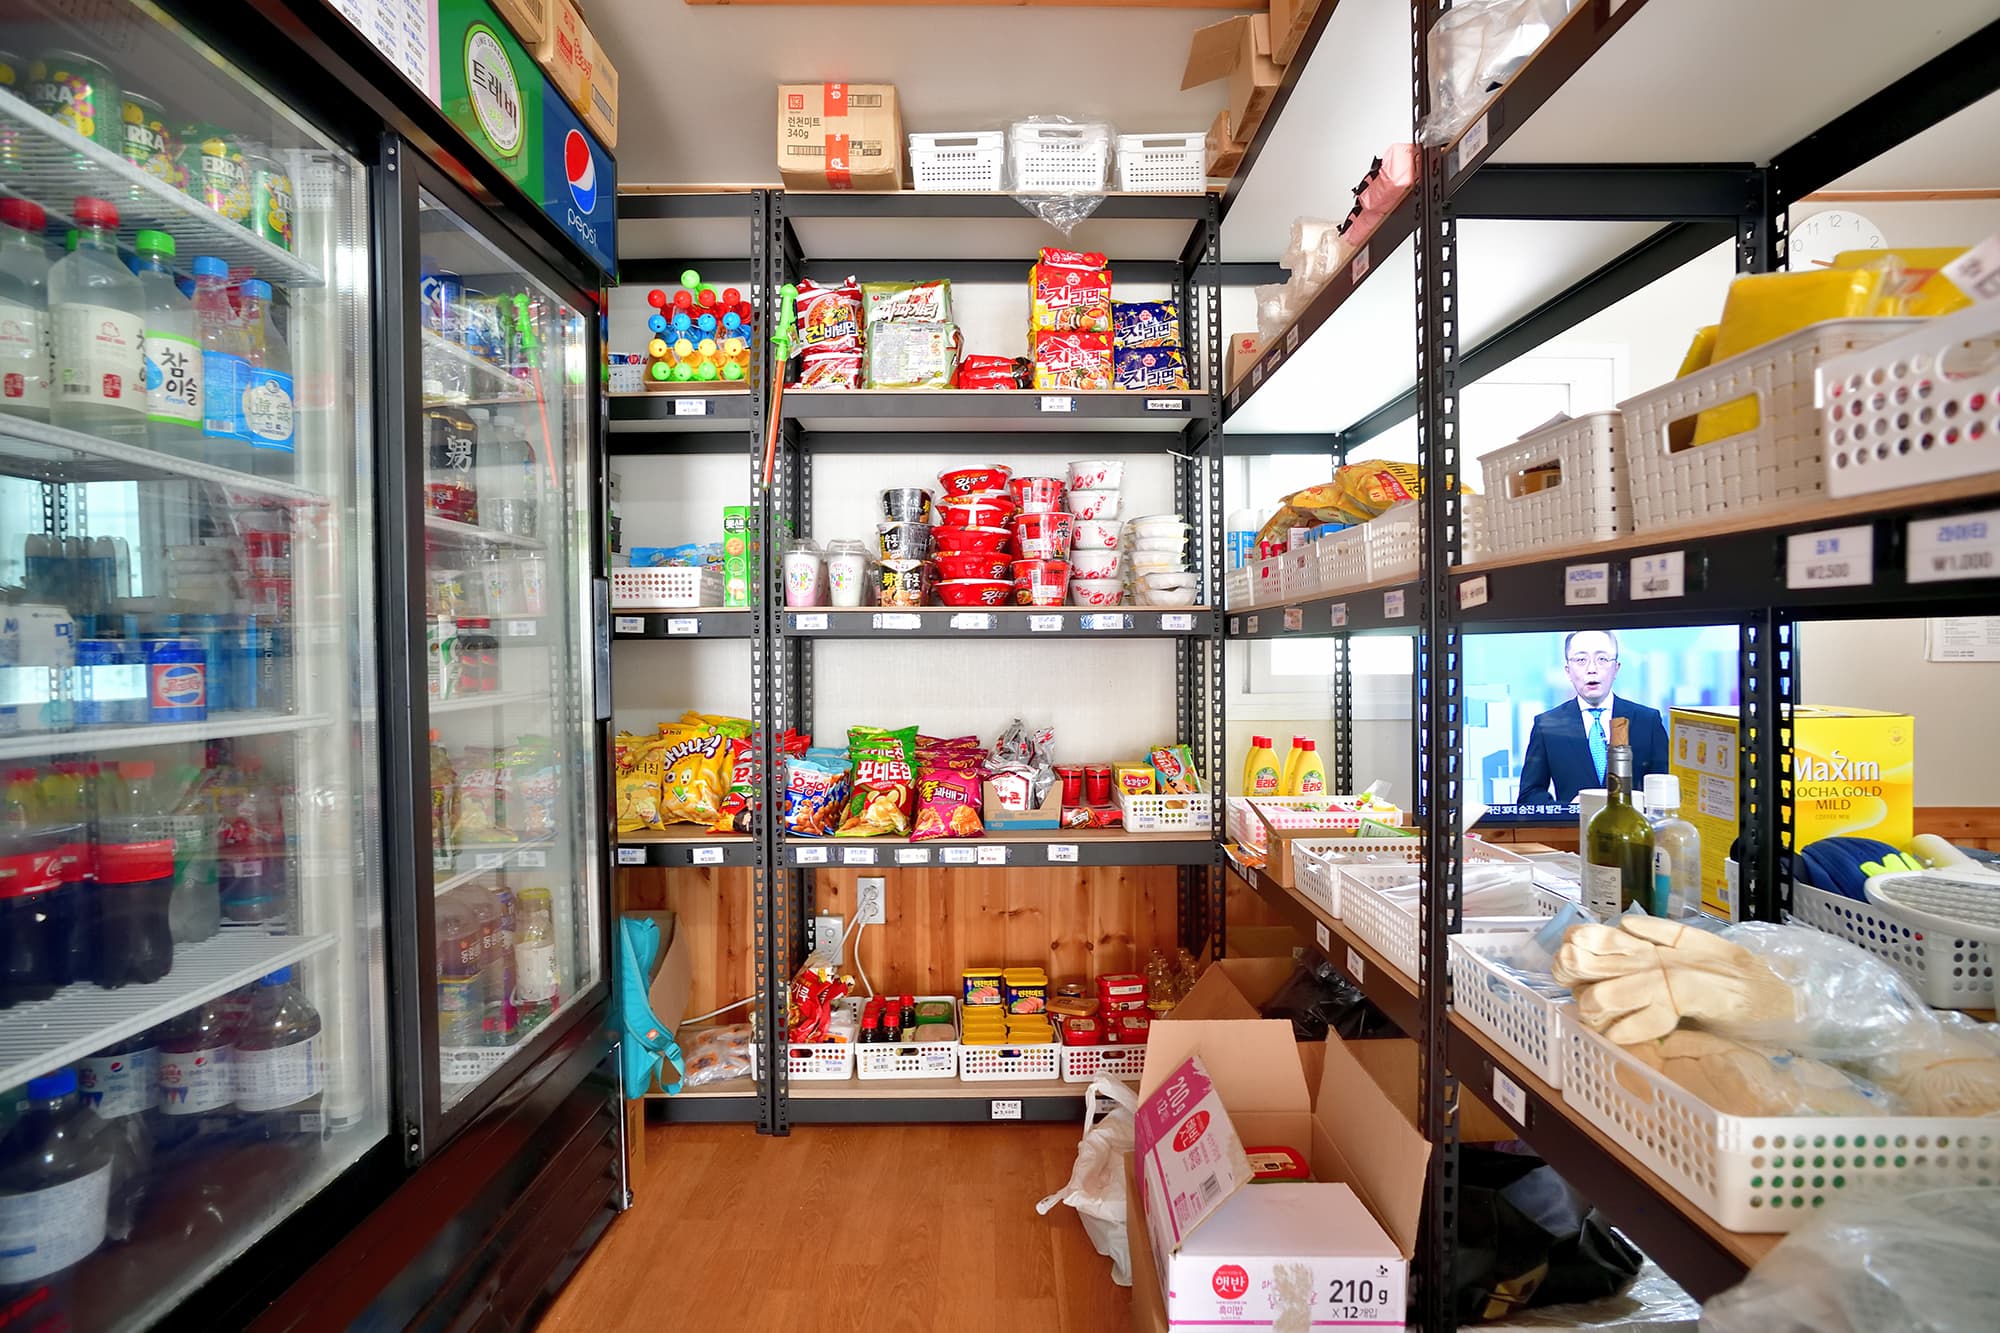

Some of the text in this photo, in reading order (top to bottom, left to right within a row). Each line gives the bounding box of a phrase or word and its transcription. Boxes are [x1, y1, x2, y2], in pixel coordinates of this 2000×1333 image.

[472, 59, 517, 128] 트레비
[787, 116, 822, 128] 런천미트
[787, 128, 809, 139] 340g
[567, 207, 597, 247] pepsi
[1807, 222, 1819, 236] 11
[1830, 214, 1842, 228] 12
[1855, 219, 1861, 232] 1
[1791, 238, 1804, 253] 10
[1869, 235, 1880, 248] 2
[1045, 285, 1100, 310] 진라면
[876, 301, 938, 321] 짜파게티
[805, 320, 859, 344] 진비빔면
[1123, 320, 1171, 346] 진라면
[1045, 349, 1100, 373] 진라면
[1123, 366, 1176, 390] 진라면
[854, 760, 912, 786] 포테토칩
[1794, 749, 1880, 782] Maxim
[786, 777, 829, 797] 오징어
[919, 780, 968, 802] 꿀꽈배기
[1255, 778, 1278, 788] 트리오
[1302, 782, 1323, 792] 트리오
[1796, 786, 1882, 797] OCHA GOLD
[1815, 800, 1851, 810] MILD
[792, 982, 810, 1002] 가루
[1214, 1275, 1246, 1293] 햇반
[1328, 1279, 1374, 1303] 210
[1378, 1289, 1388, 1304] g
[1218, 1305, 1244, 1316] 흑미밥
[1343, 1306, 1379, 1319] 12개입
